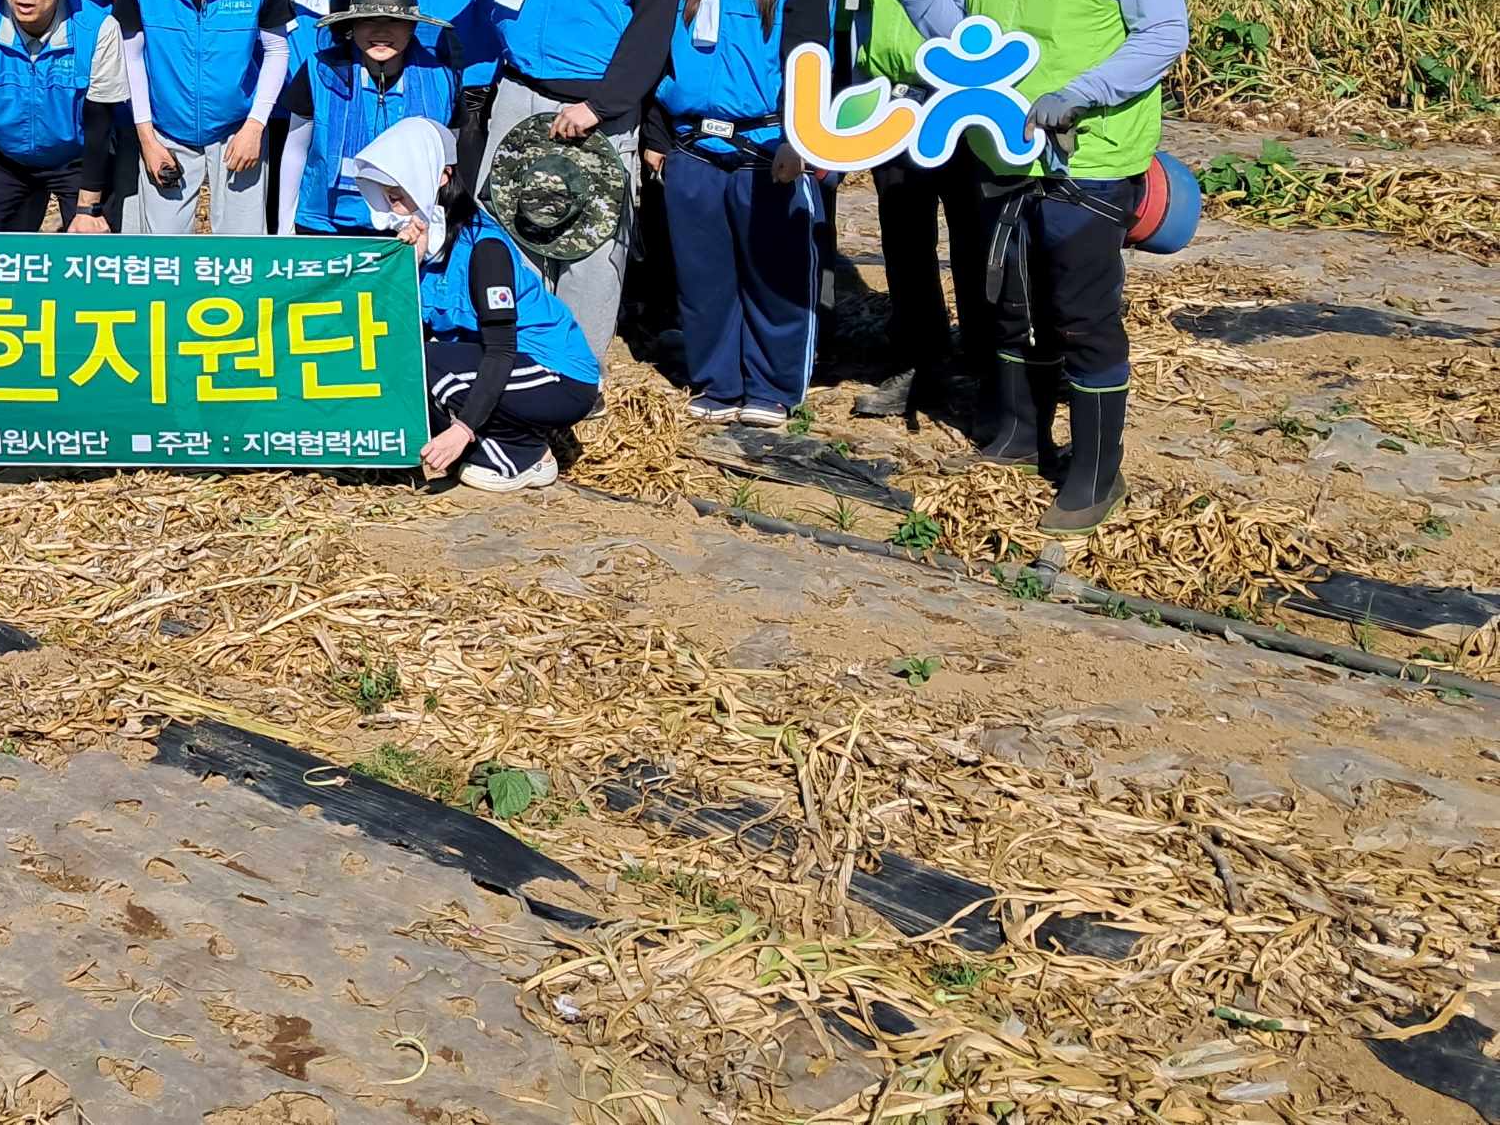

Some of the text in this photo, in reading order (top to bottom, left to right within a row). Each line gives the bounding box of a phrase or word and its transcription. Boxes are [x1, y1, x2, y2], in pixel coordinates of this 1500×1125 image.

[64, 253, 180, 285] 지역협력
[194, 256, 252, 286] 학생
[265, 251, 382, 279] 서포터즈
[156, 430, 212, 455] 주관
[243, 428, 406, 457] 지역협력센터
